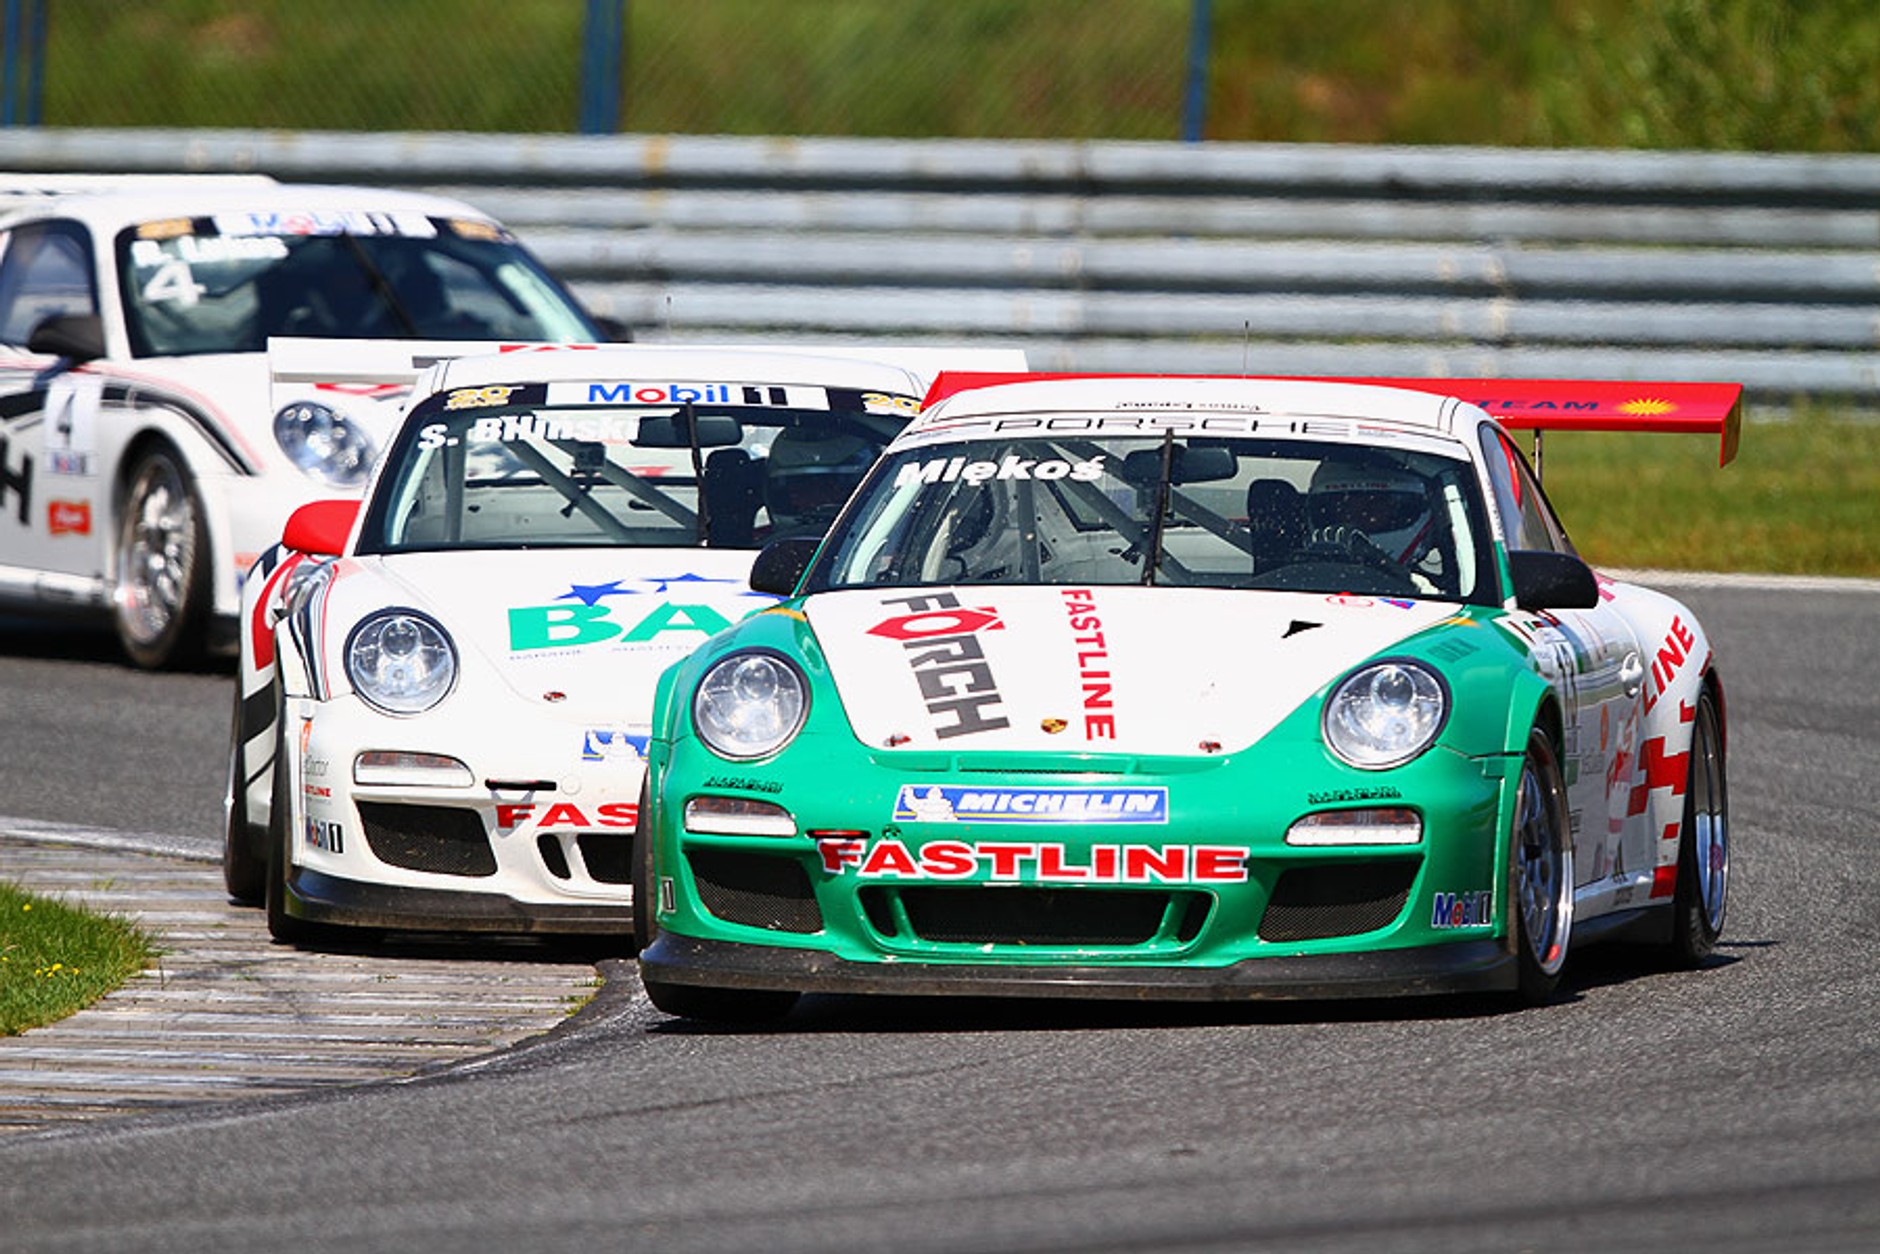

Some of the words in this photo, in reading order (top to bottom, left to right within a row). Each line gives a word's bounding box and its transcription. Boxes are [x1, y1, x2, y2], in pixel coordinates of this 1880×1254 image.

[143, 260, 206, 305] 4
[588, 384, 729, 403] Mobil
[1475, 400, 1599, 411] TEAM
[418, 424, 458, 450] S.
[994, 416, 1350, 437] PORSCHE
[508, 601, 760, 650] BA
[1061, 589, 1117, 741] FASTLINE
[957, 792, 1158, 813] MICHELIN
[819, 840, 1248, 882] FASTLINE
[1432, 893, 1479, 926] Mobil
